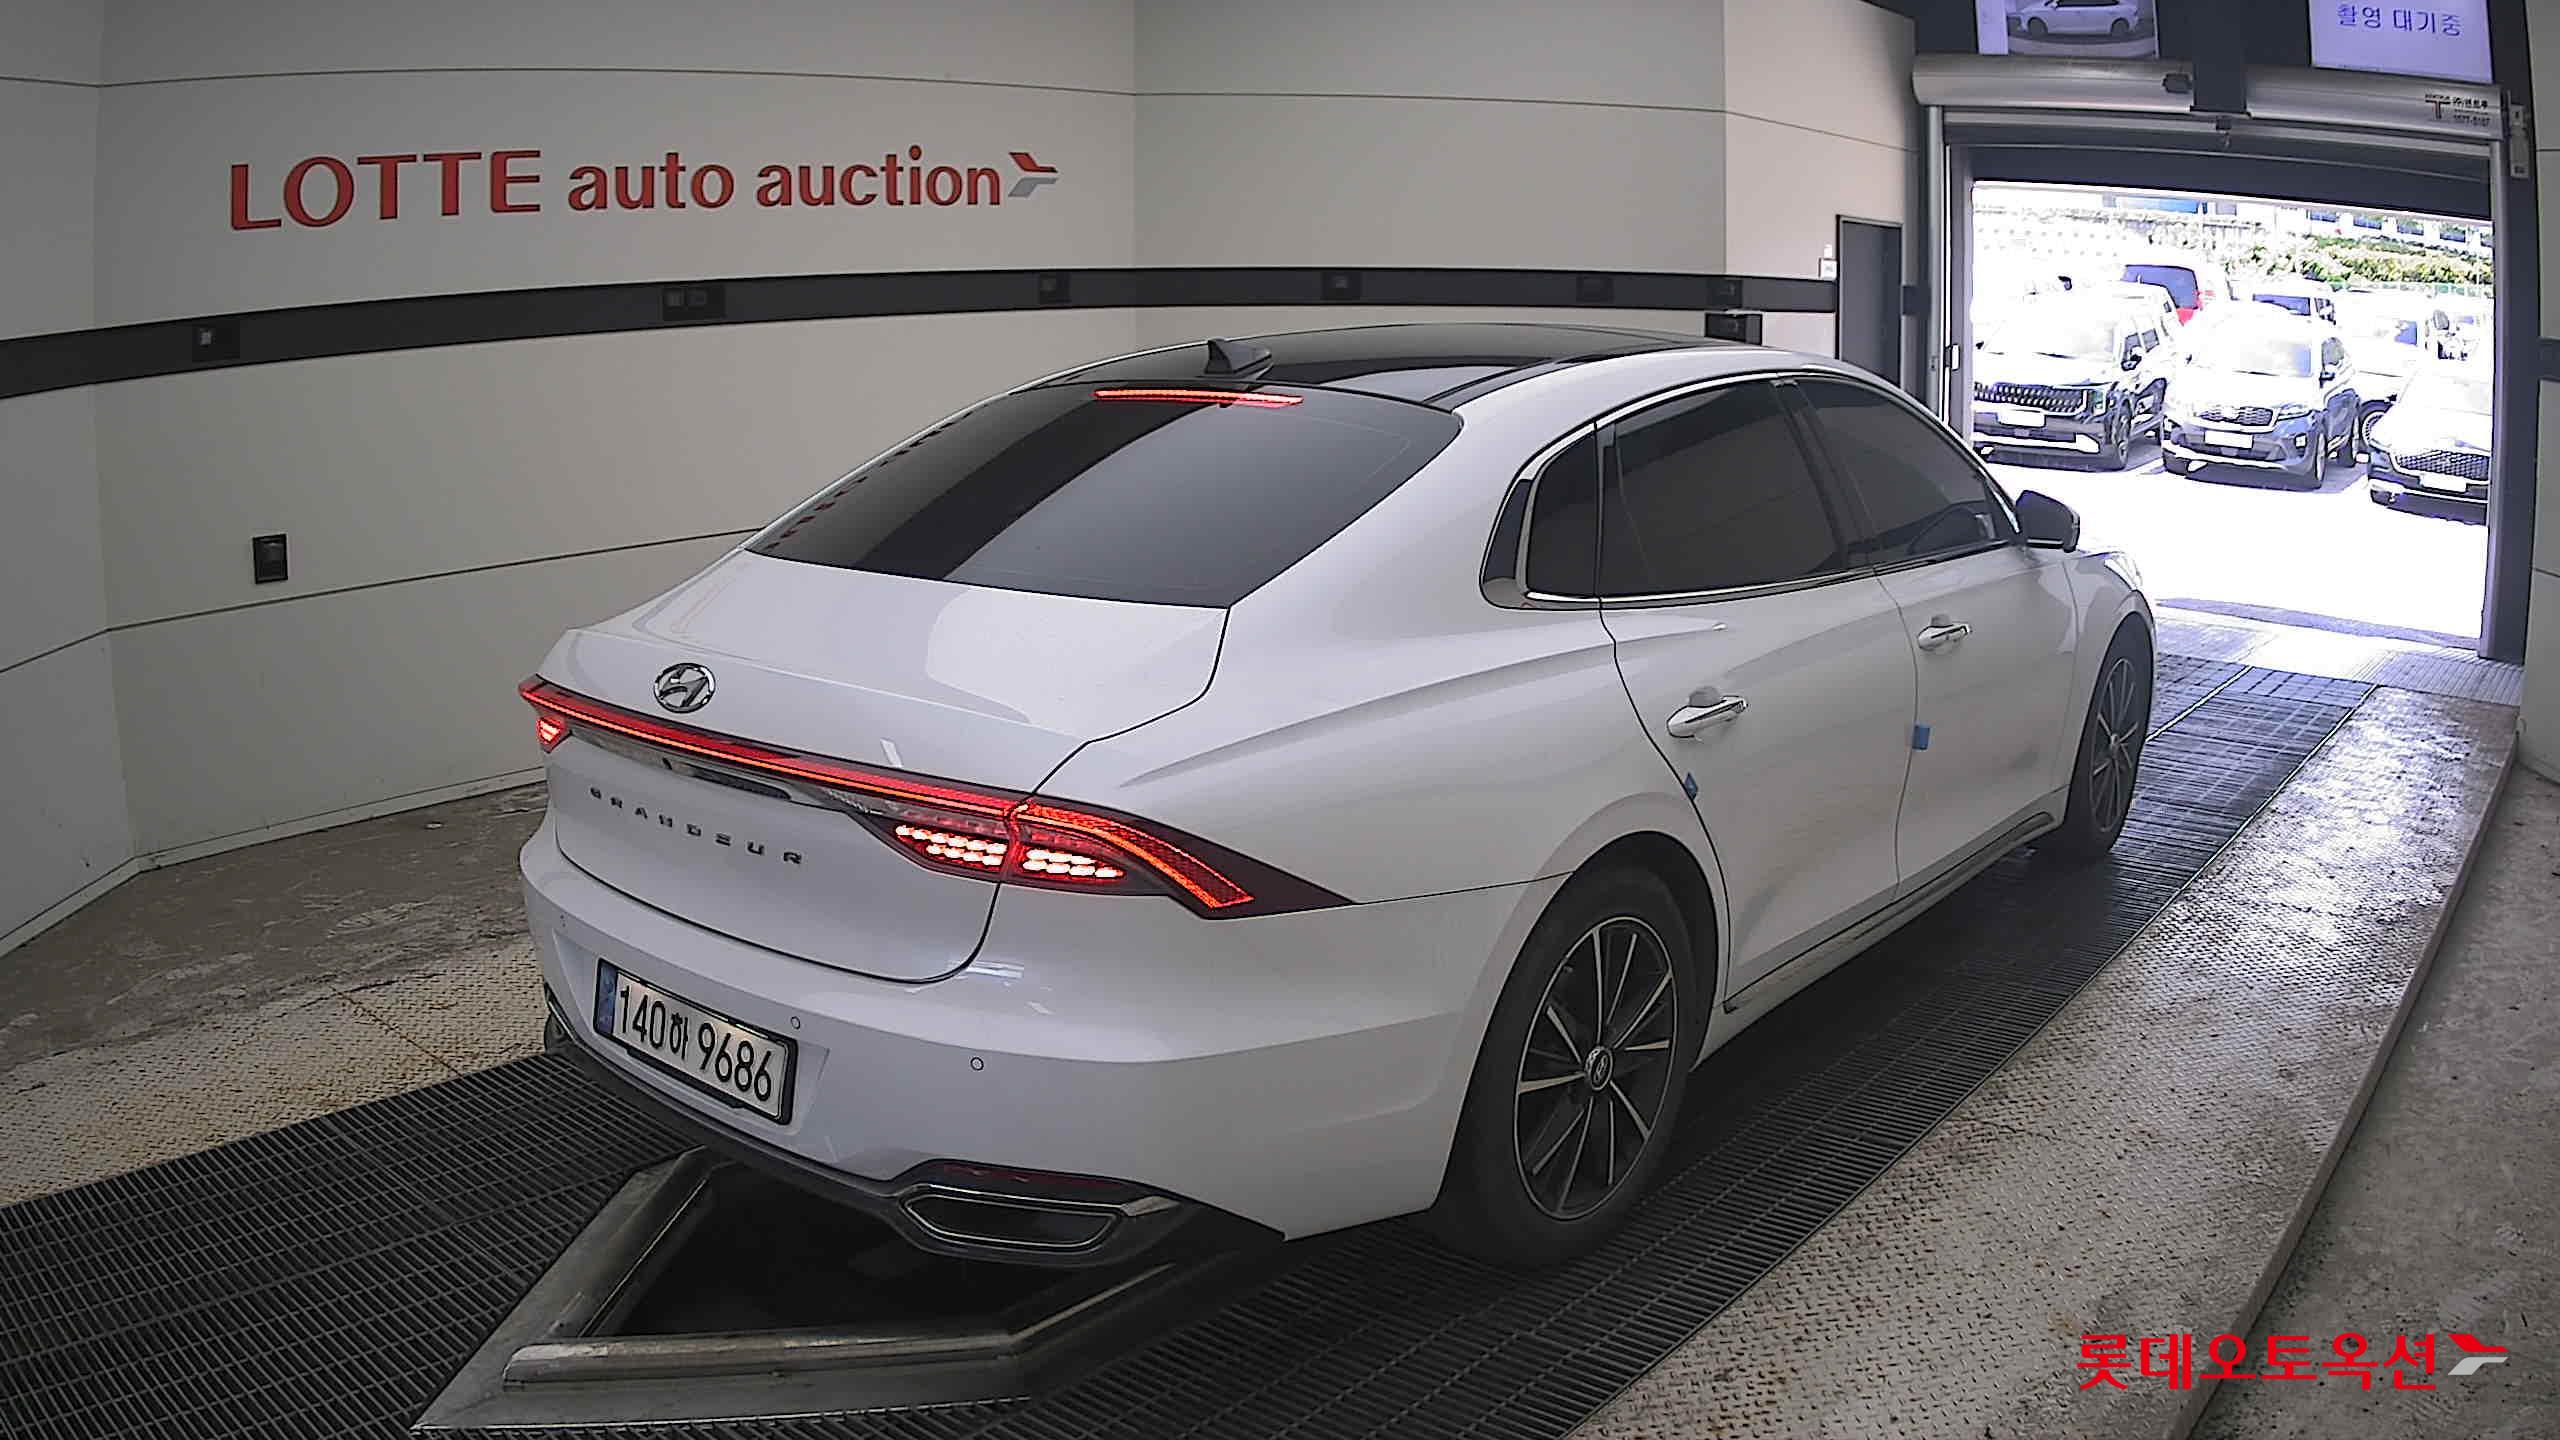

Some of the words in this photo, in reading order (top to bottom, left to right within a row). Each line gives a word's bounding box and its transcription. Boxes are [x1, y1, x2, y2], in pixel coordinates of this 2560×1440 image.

[2338, 4, 2381, 28] 촬영
[2393, 9, 2460, 36] 대기중
[231, 150, 540, 229] LOTTE
[569, 153, 735, 210] auto
[756, 146, 1003, 207] auction
[590, 787, 802, 864] GRANDEUR
[620, 985, 689, 1060] 140하
[698, 1022, 772, 1101] 9686
